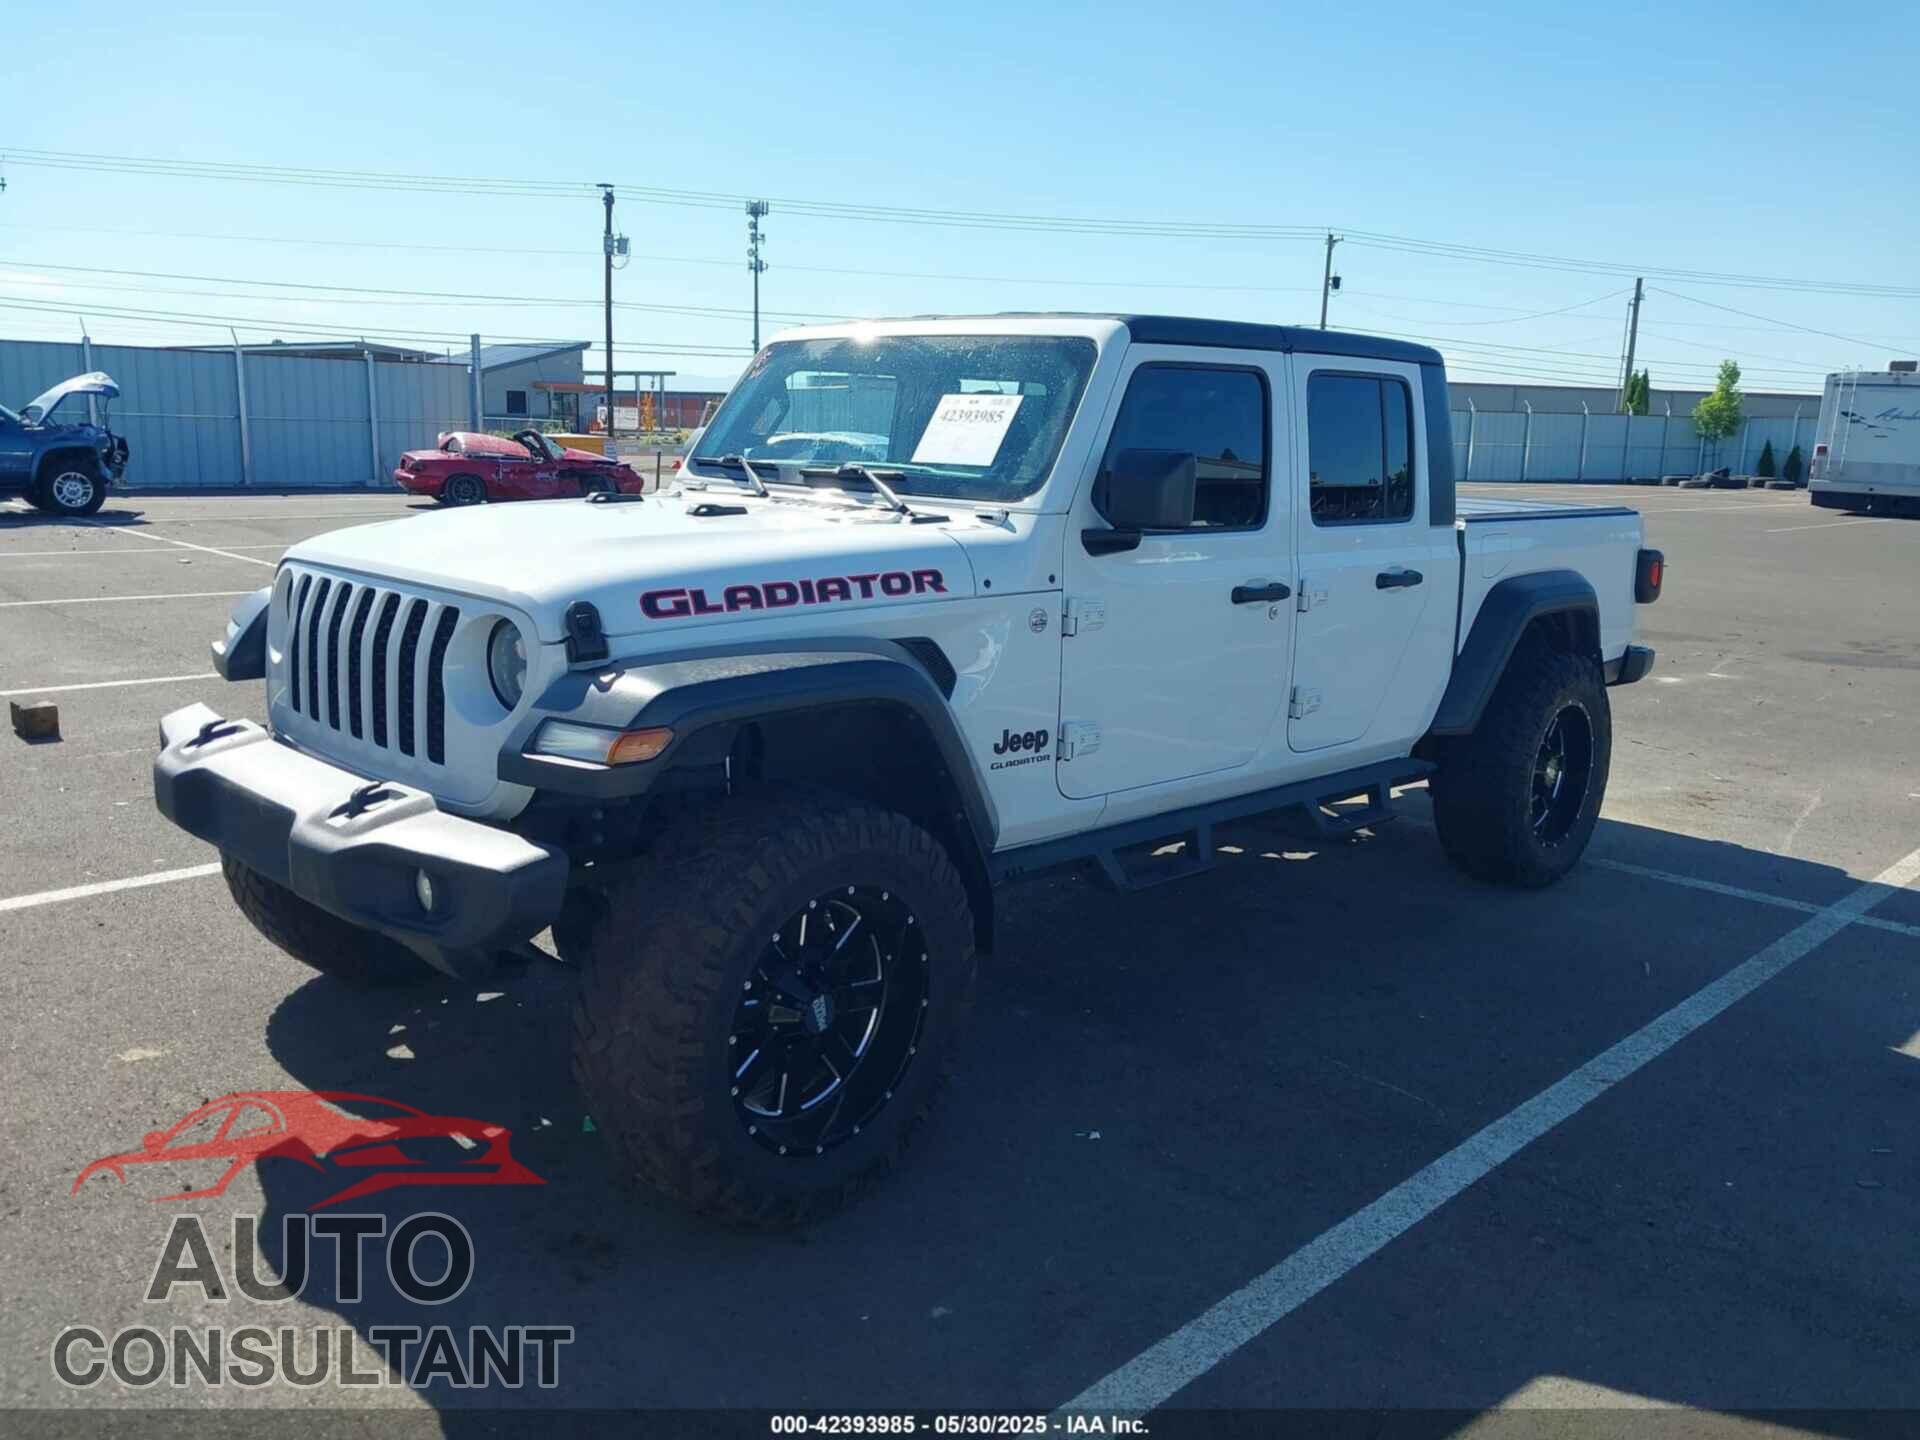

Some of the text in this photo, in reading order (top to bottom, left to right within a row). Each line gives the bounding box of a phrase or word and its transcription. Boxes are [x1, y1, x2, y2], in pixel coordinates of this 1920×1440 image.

[941, 408, 1005, 424] 42393985
[639, 568, 949, 620] GLADIATOR
[993, 728, 1049, 755] Jeep
[989, 754, 1051, 770] GLADIATOR
